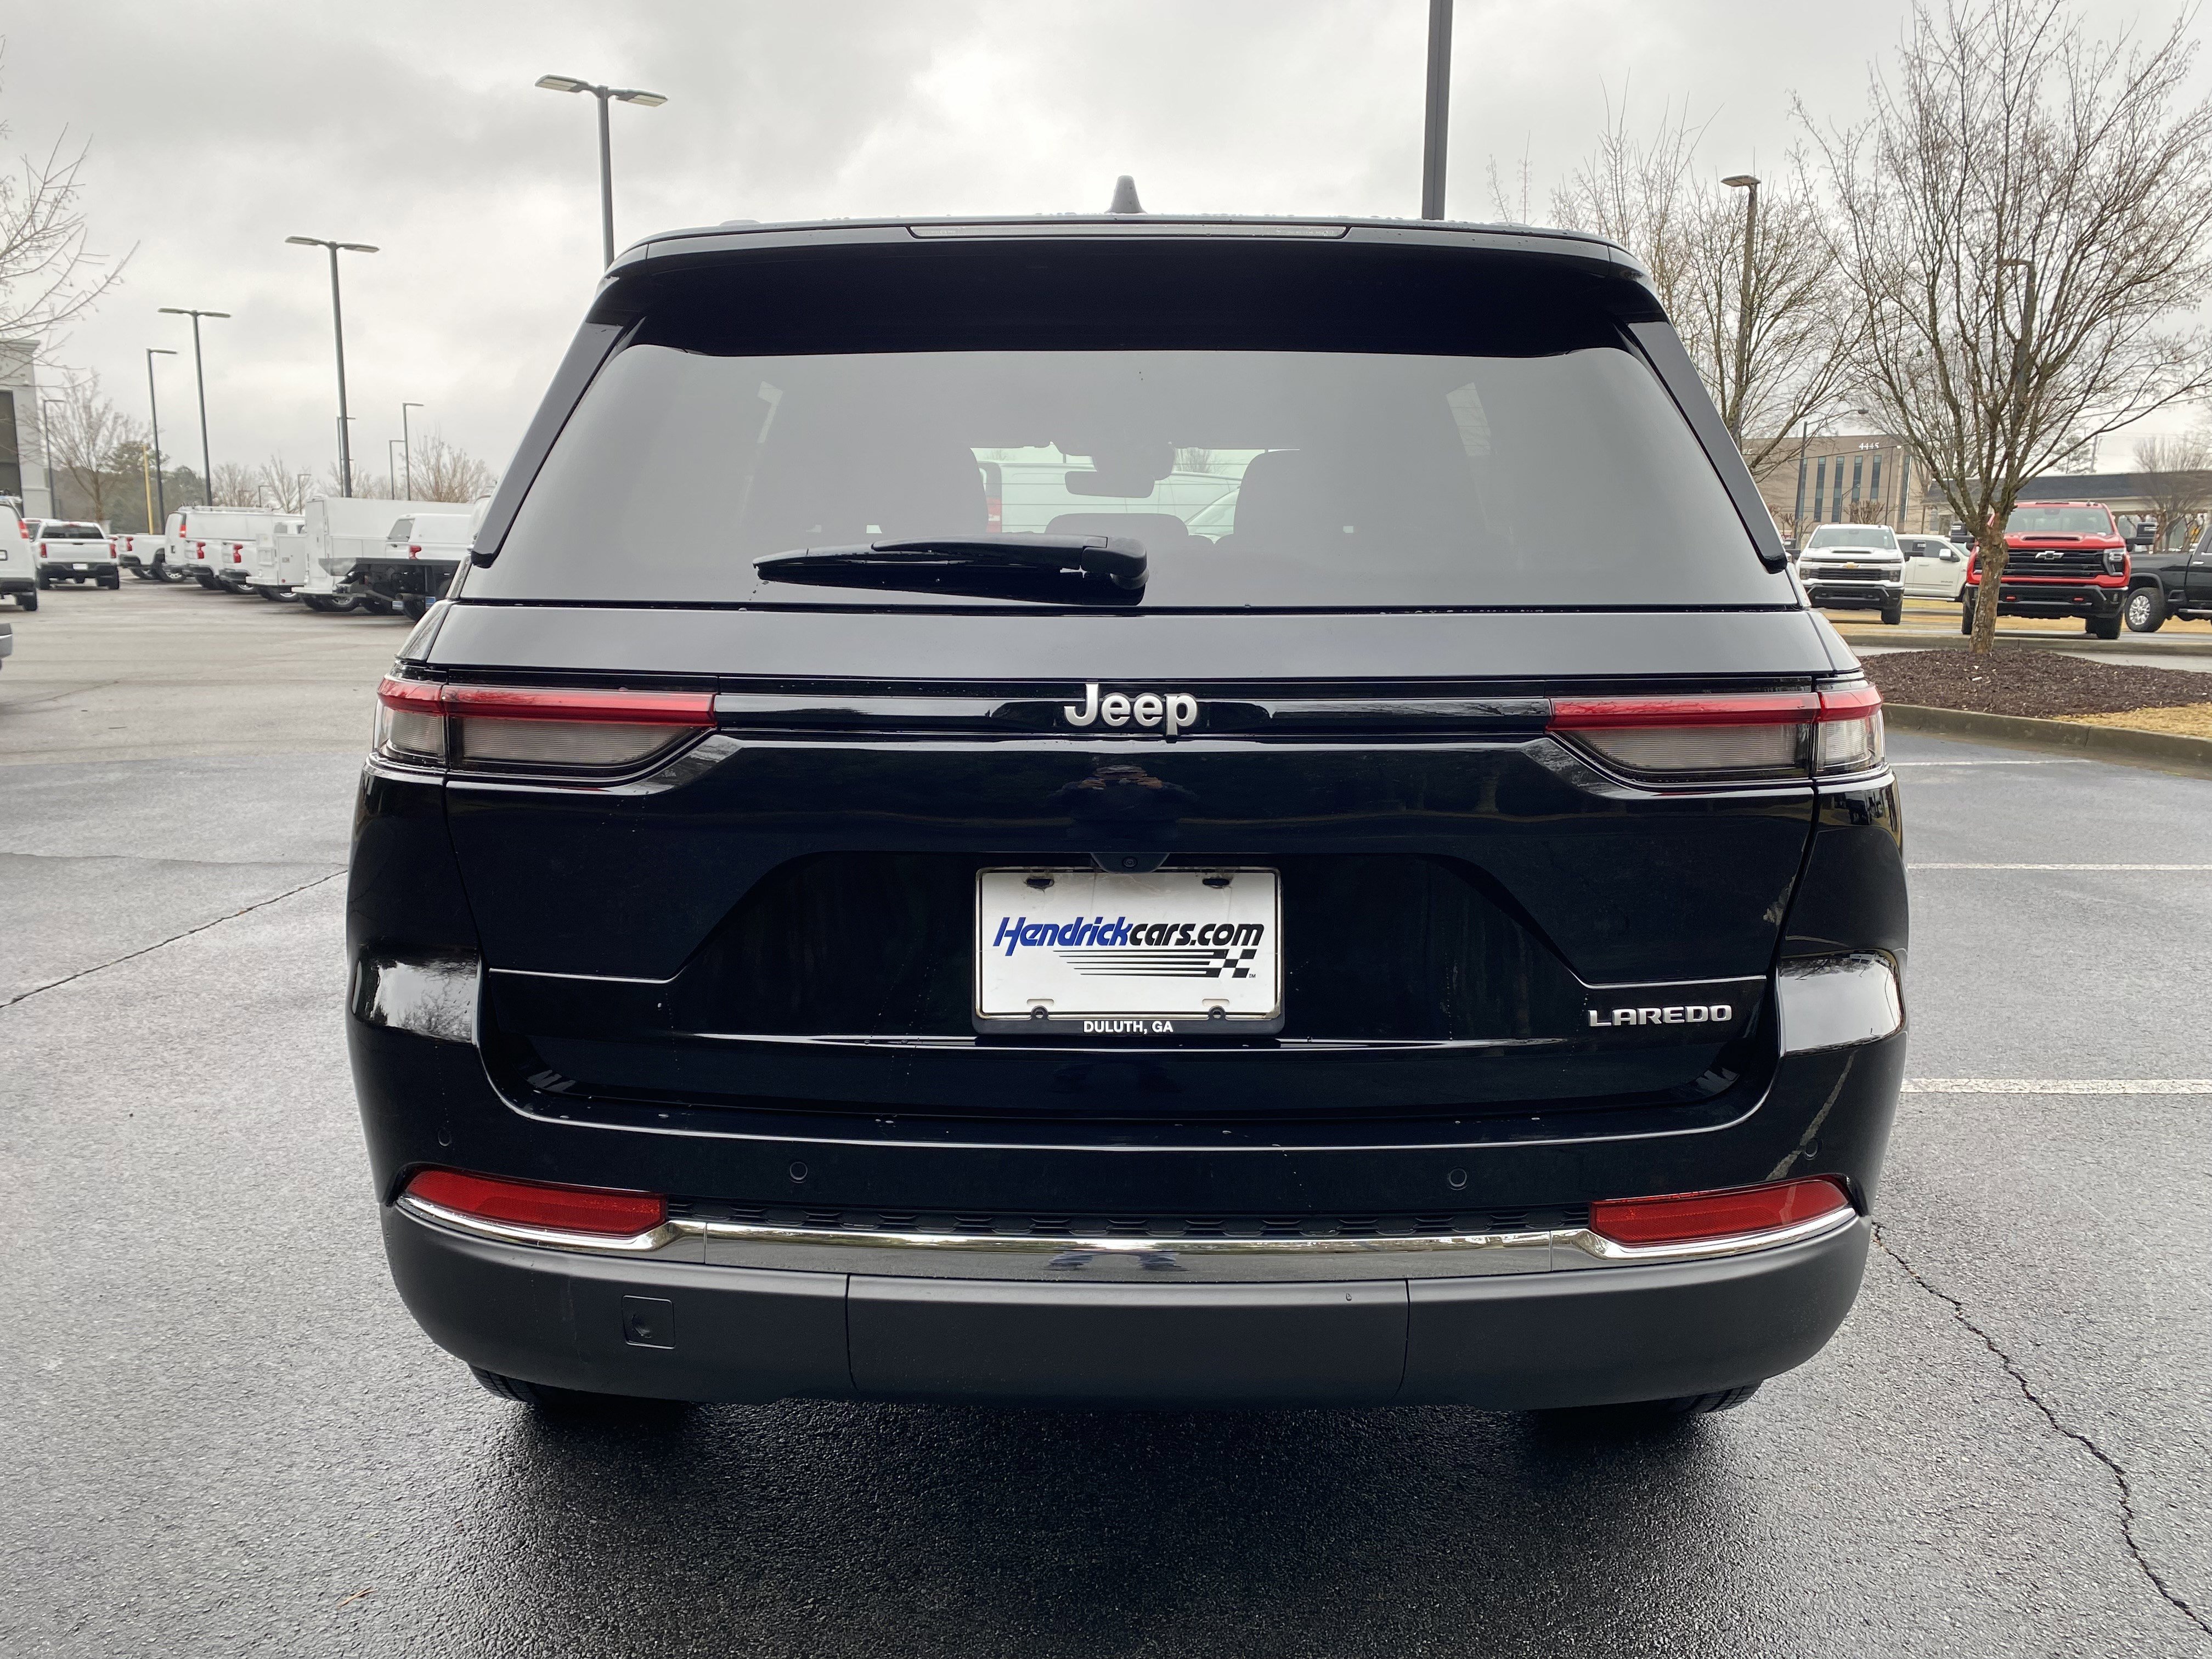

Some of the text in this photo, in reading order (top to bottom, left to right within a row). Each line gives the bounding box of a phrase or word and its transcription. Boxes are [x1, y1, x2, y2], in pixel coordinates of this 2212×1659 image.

[1063, 682, 1198, 736] Jeep
[992, 917, 1265, 957] Hendrickcars.com
[1084, 1020, 1173, 1035] DULUTH, GA
[1588, 1005, 1732, 1026] LAREDO
